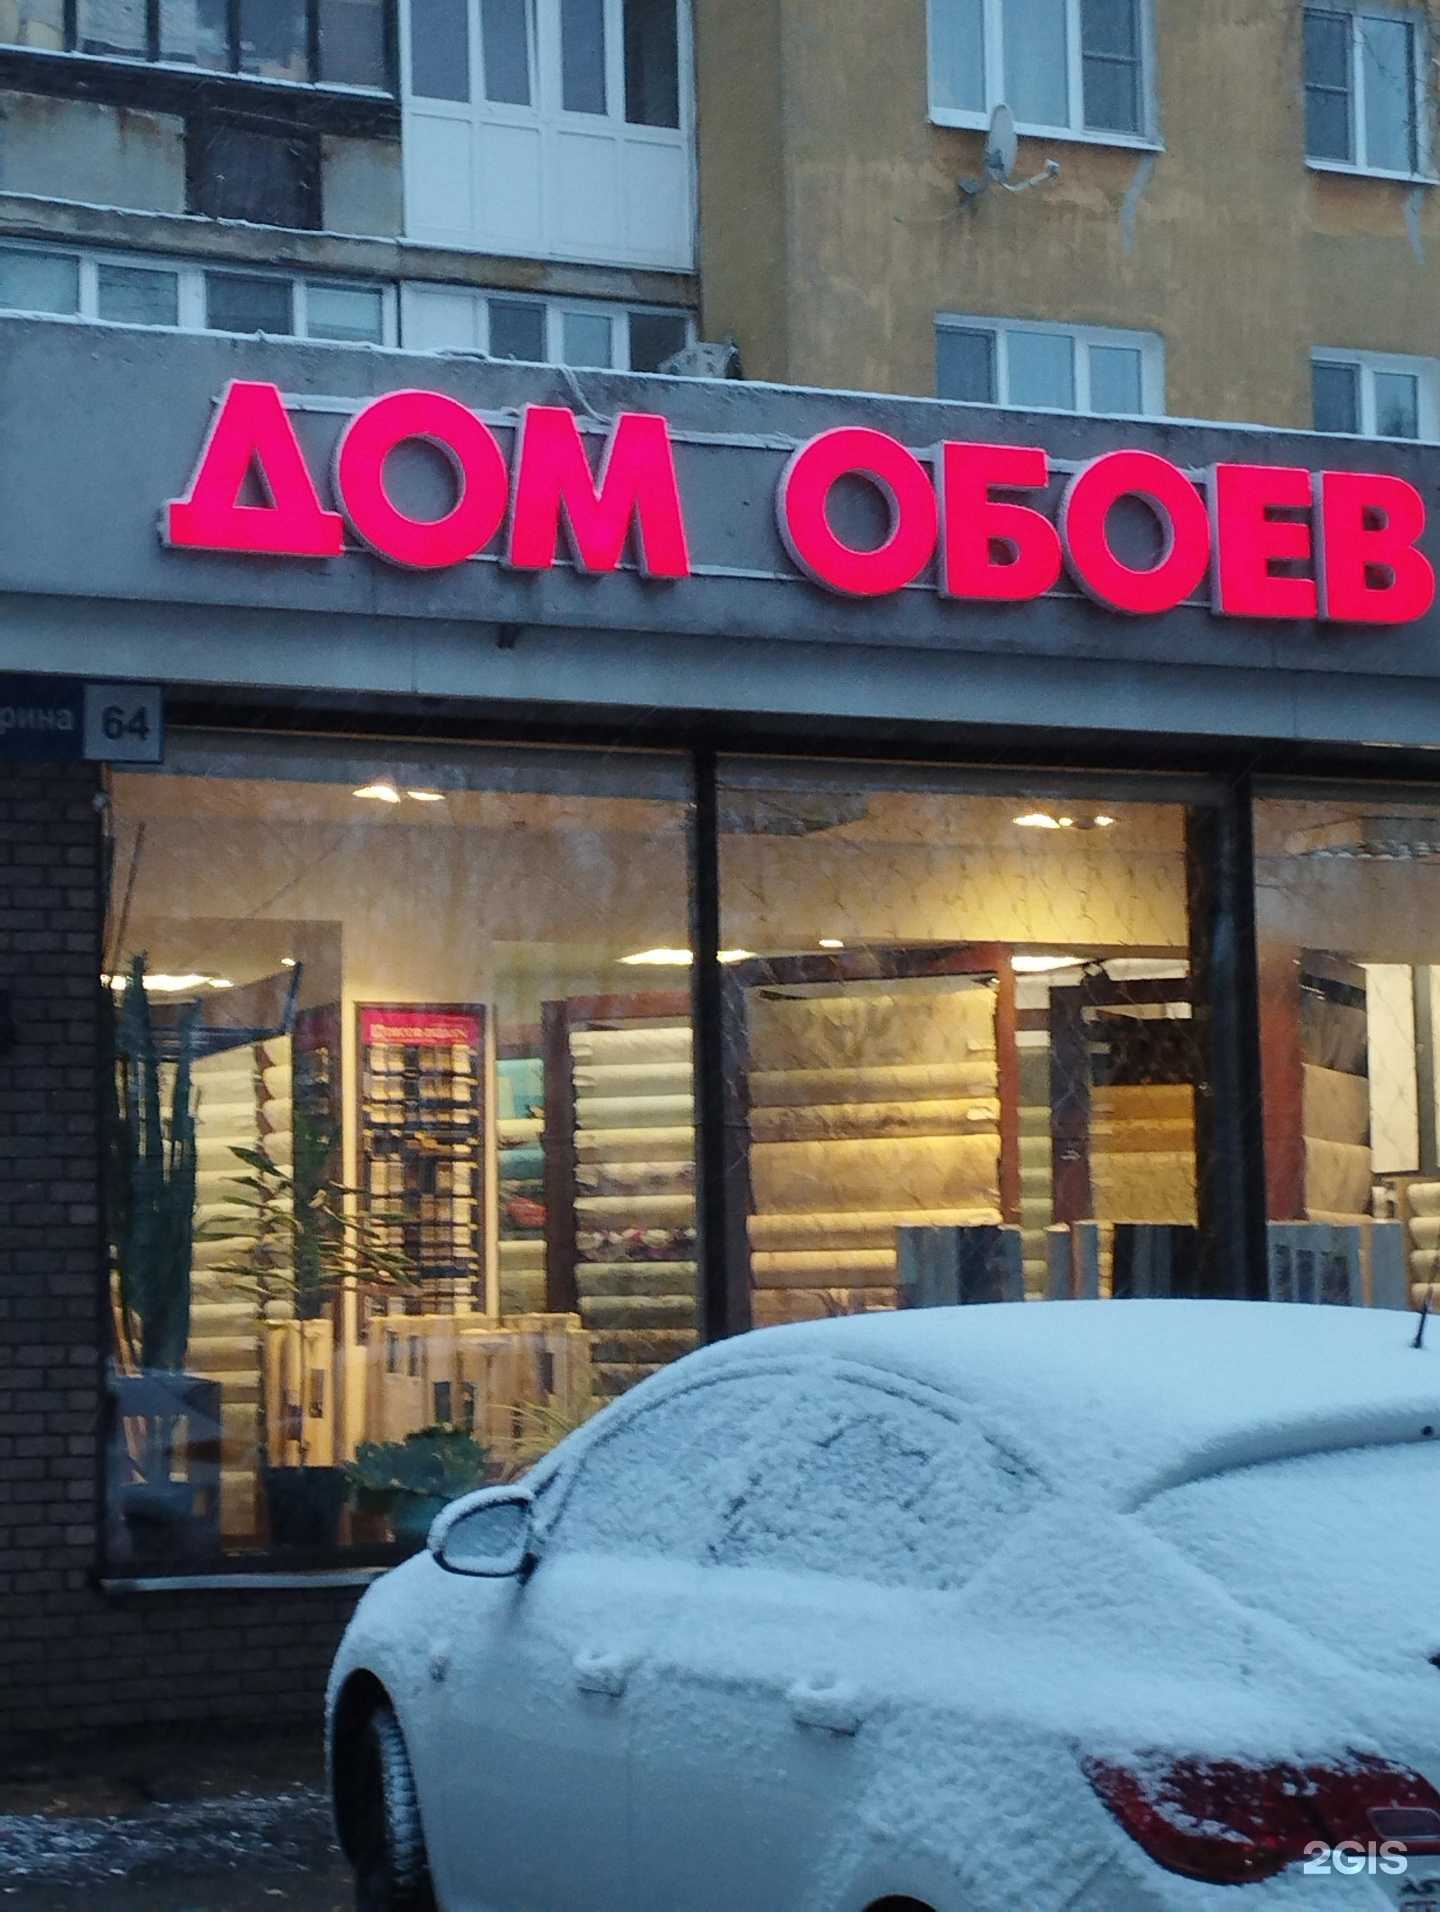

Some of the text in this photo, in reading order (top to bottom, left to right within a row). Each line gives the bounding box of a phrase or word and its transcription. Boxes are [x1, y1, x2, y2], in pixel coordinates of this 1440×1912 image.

[163, 379, 1436, 625] ДОМ ОБОЕВ
[103, 705, 149, 741] 64
